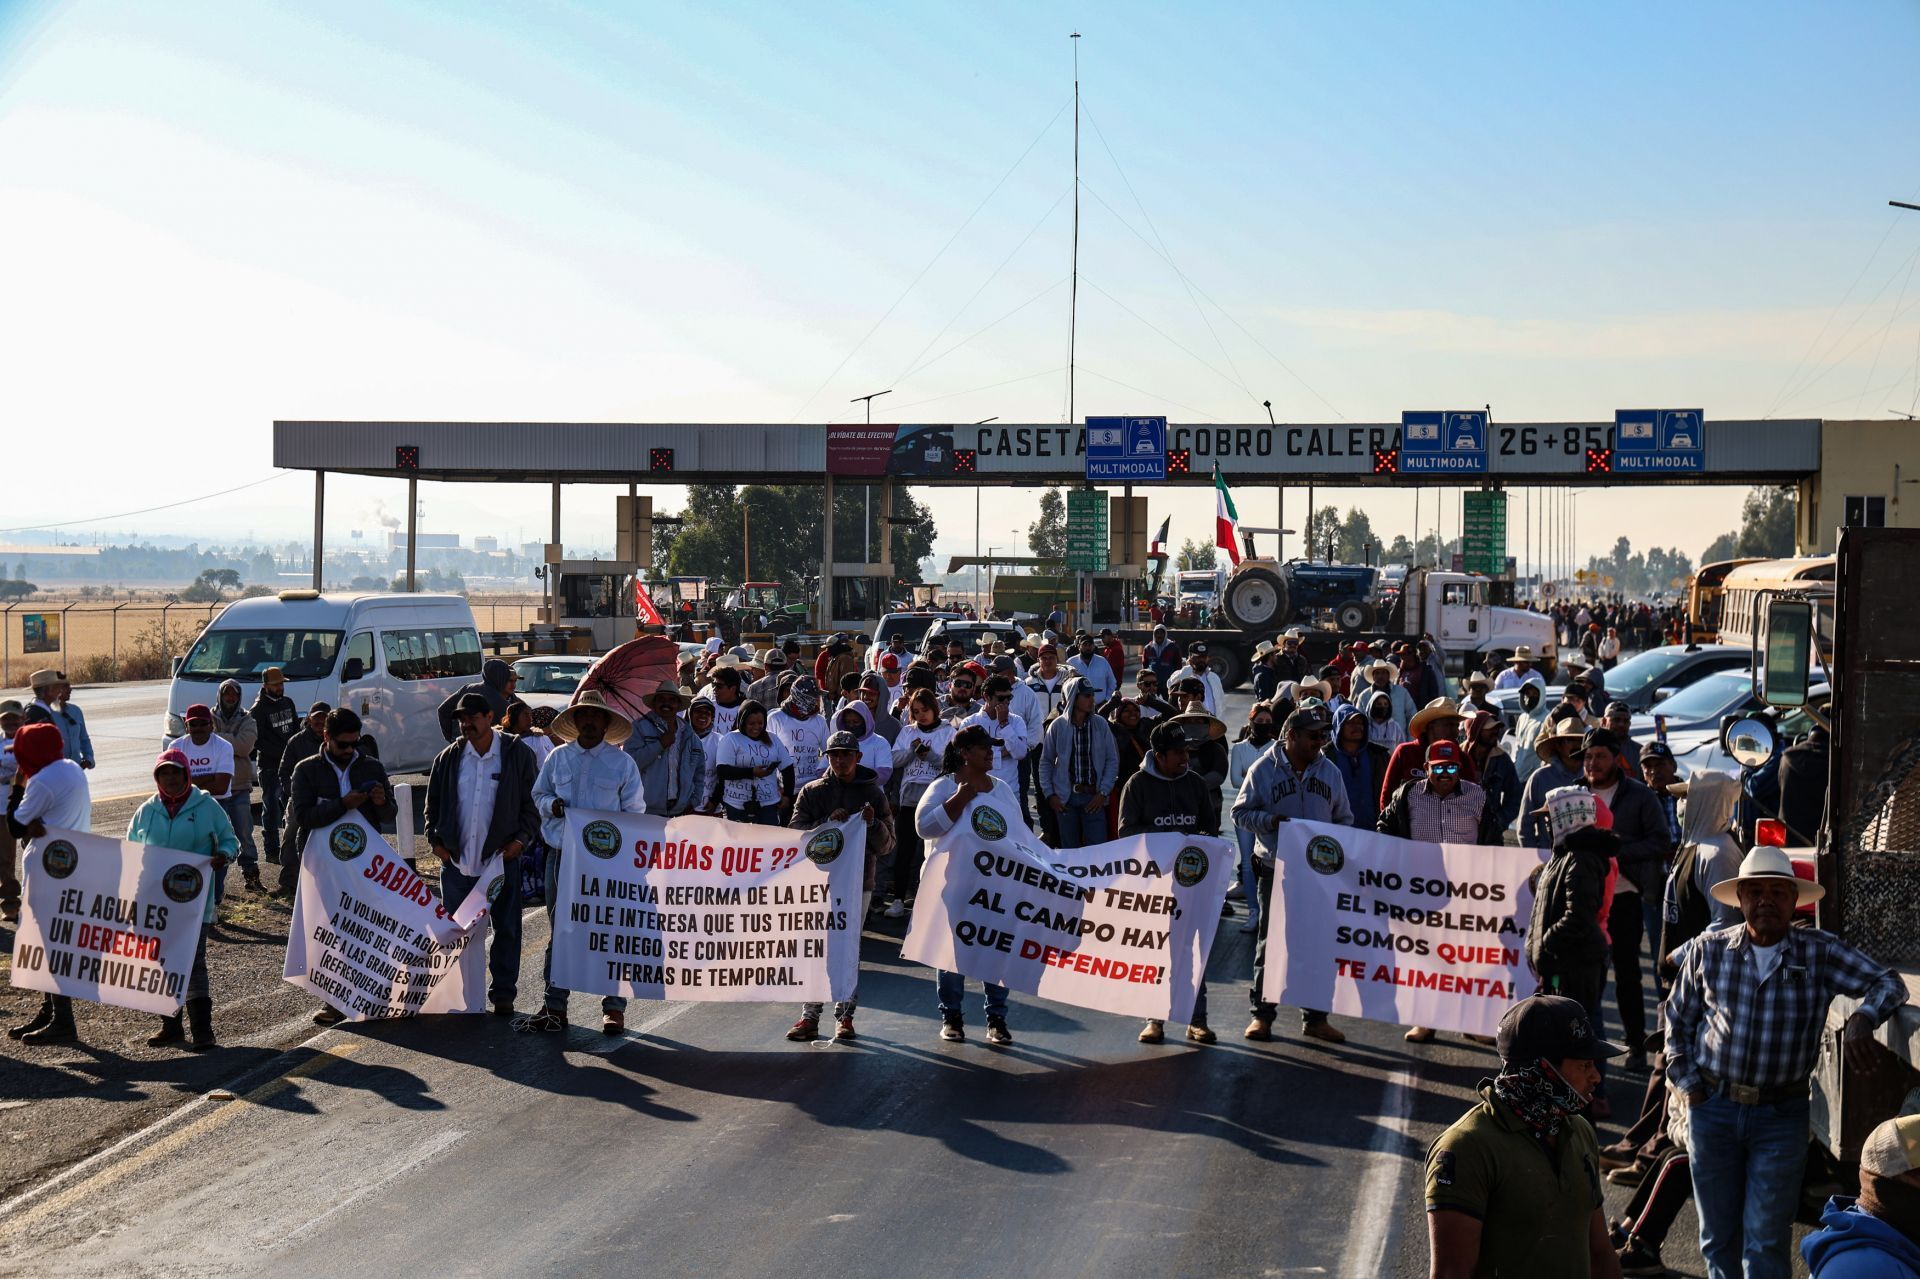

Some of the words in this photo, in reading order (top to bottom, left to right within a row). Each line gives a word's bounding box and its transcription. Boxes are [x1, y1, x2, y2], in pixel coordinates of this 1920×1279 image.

[977, 428, 1086, 457] CASETA
[1175, 428, 1272, 456] COBRO
[1090, 462, 1162, 474] MULTIMODAL
[1407, 457, 1480, 468] MULTIMODAL
[1620, 456, 1696, 468] MULTIMODAL
[748, 744, 770, 758] NO
[792, 728, 804, 742] NO
[190, 758, 210, 766] NO
[1154, 814, 1196, 826] adidas
[634, 839, 714, 870] SABÍAS
[721, 847, 762, 876] QUE
[770, 847, 798, 871] ??
[580, 874, 600, 897] LA
[606, 879, 658, 905] NUEVA
[666, 886, 741, 906] REFORMA
[748, 886, 768, 905] DE
[774, 885, 794, 905] LA
[974, 850, 1095, 904] QUIEREN
[1104, 888, 1182, 921] TENER,
[1358, 869, 1402, 890] ¡NO
[1409, 878, 1506, 902] SOMOS
[58, 888, 84, 916] ¡EL
[90, 894, 137, 926] AGUA
[144, 904, 168, 931] ES
[339, 891, 352, 910] TU
[353, 900, 399, 932] VOLUMEN
[400, 924, 414, 942] DE
[571, 902, 590, 923] NO
[596, 906, 614, 926] LE
[620, 907, 698, 933] INTERESA
[704, 913, 734, 936] QUE
[740, 913, 772, 932] TUS
[778, 911, 847, 932] TIERRAS
[968, 888, 1005, 914] AL
[1014, 901, 1115, 942] CAMPO
[1121, 927, 1171, 951] HAY
[1336, 893, 1366, 913] EL
[1374, 902, 1526, 938] PROBLEMA,
[49, 918, 73, 944] UN
[77, 923, 166, 966] DERECHO,
[330, 913, 340, 927] A
[340, 918, 375, 945] MANOS
[373, 936, 389, 954] DEL
[589, 931, 608, 952] DE
[614, 934, 662, 958] RIEGO
[668, 940, 689, 959] SE
[694, 939, 798, 961] CONVIERTAN
[803, 938, 824, 958] EN
[1335, 926, 1430, 956] SOMOS
[1436, 943, 1520, 966] QUIEN
[313, 926, 339, 948] ENDE
[340, 941, 348, 954] A
[348, 946, 365, 964] LAS
[366, 955, 411, 985] GRANDES
[955, 920, 1015, 953] QUE
[1019, 939, 1165, 985] DEFENDER!
[17, 944, 44, 970] NO
[49, 951, 73, 977] UN
[78, 955, 185, 999] PRIVILEGIO!
[310, 968, 353, 1008] LECHERAS,
[607, 961, 675, 986] TIERRAS
[682, 967, 702, 986] DE
[708, 966, 804, 986] TEMPORAL.
[1335, 958, 1366, 979] TE
[1372, 965, 1515, 1000] ALIMENTA!
